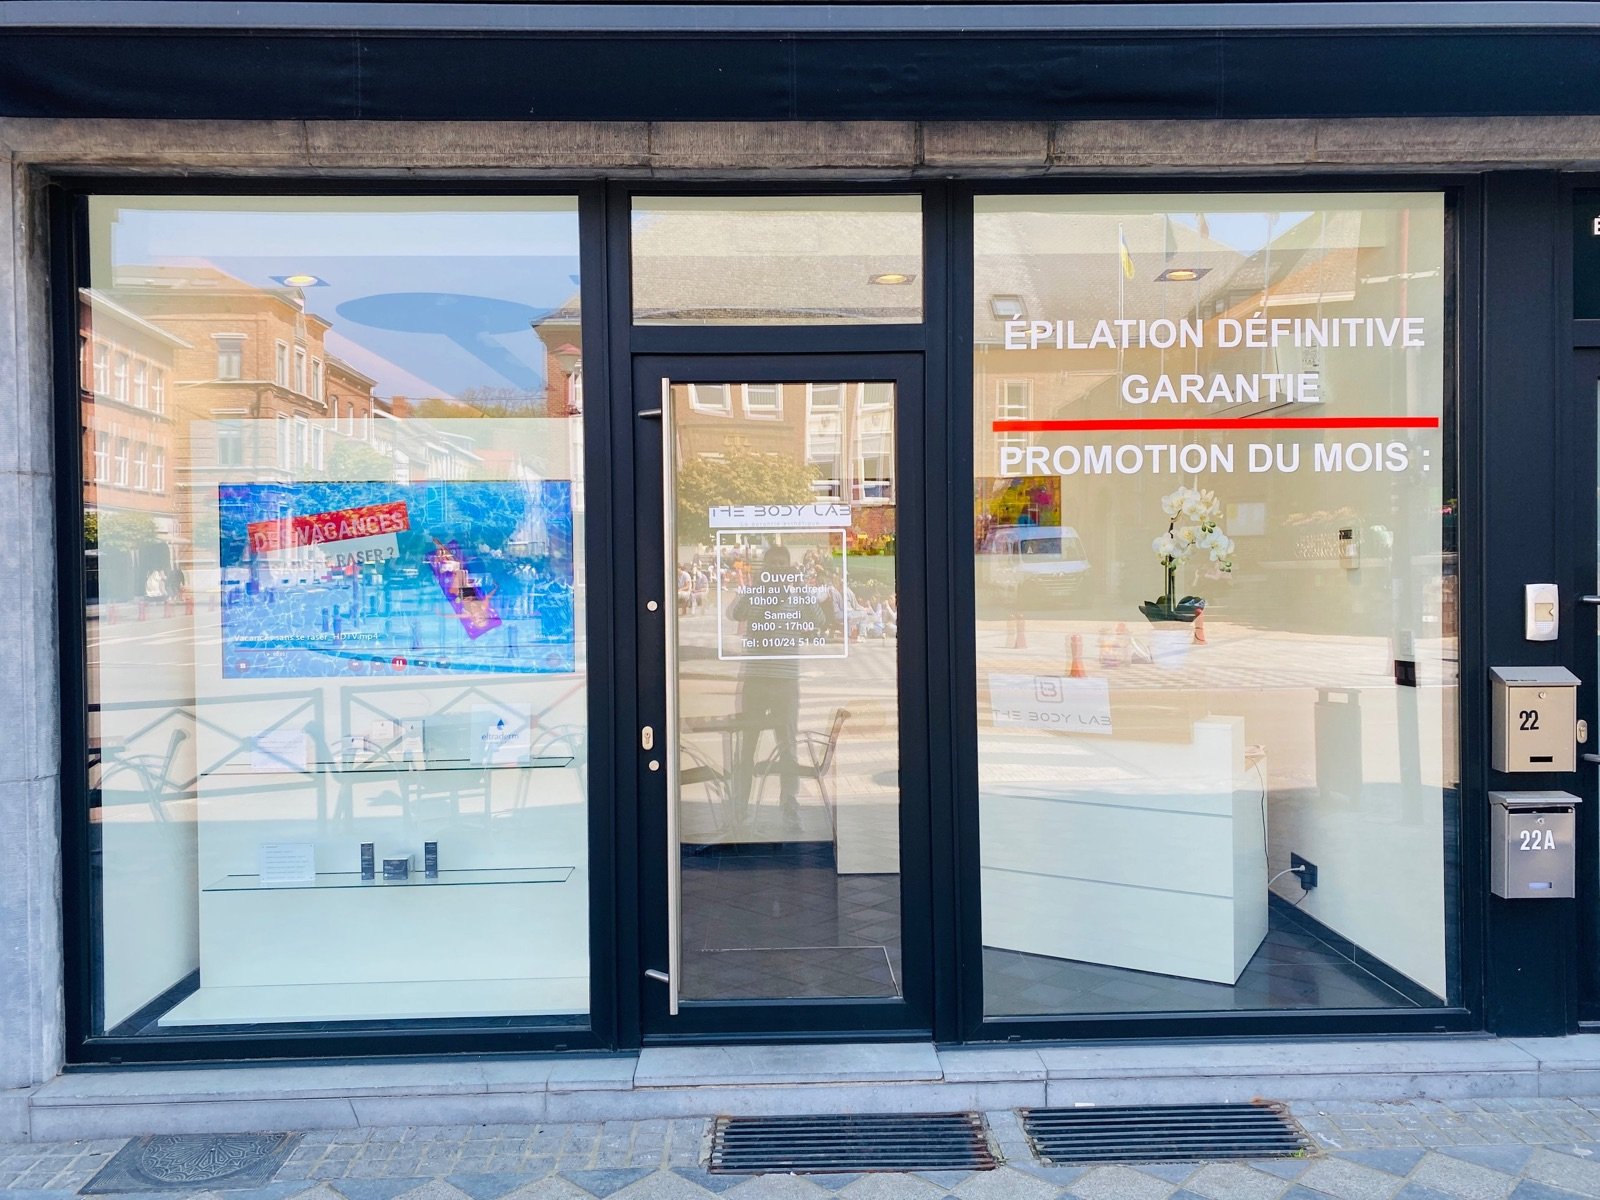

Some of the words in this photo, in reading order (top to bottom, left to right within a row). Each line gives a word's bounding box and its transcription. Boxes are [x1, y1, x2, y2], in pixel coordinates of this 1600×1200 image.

[1004, 313, 1204, 350] ÉPILATION
[1217, 311, 1425, 348] DÉFINITIVE
[1121, 373, 1320, 405] GARANTIE
[1000, 443, 1234, 475] PROMOTION
[1248, 443, 1300, 473] DU
[1314, 442, 1409, 472] MOIS
[708, 505, 745, 518] THE
[754, 504, 806, 517] BODY
[813, 503, 850, 517] LAB
[336, 547, 384, 567] RASER
[760, 572, 804, 583] Ouvert
[737, 585, 766, 594] Mardi
[783, 584, 827, 594] Vendredi
[749, 596, 778, 605] 10h00
[787, 596, 817, 605] 18h30
[764, 610, 801, 620] Samedi
[751, 622, 776, 631] 9h00
[785, 621, 814, 631] 17h00
[741, 638, 760, 648] Tel:
[762, 638, 795, 647] 010/24
[992, 708, 1022, 720] THE
[1028, 711, 1072, 723] BODY
[1079, 715, 1112, 726] LAB
[1519, 709, 1540, 731] 22
[1519, 829, 1556, 851] 22A
